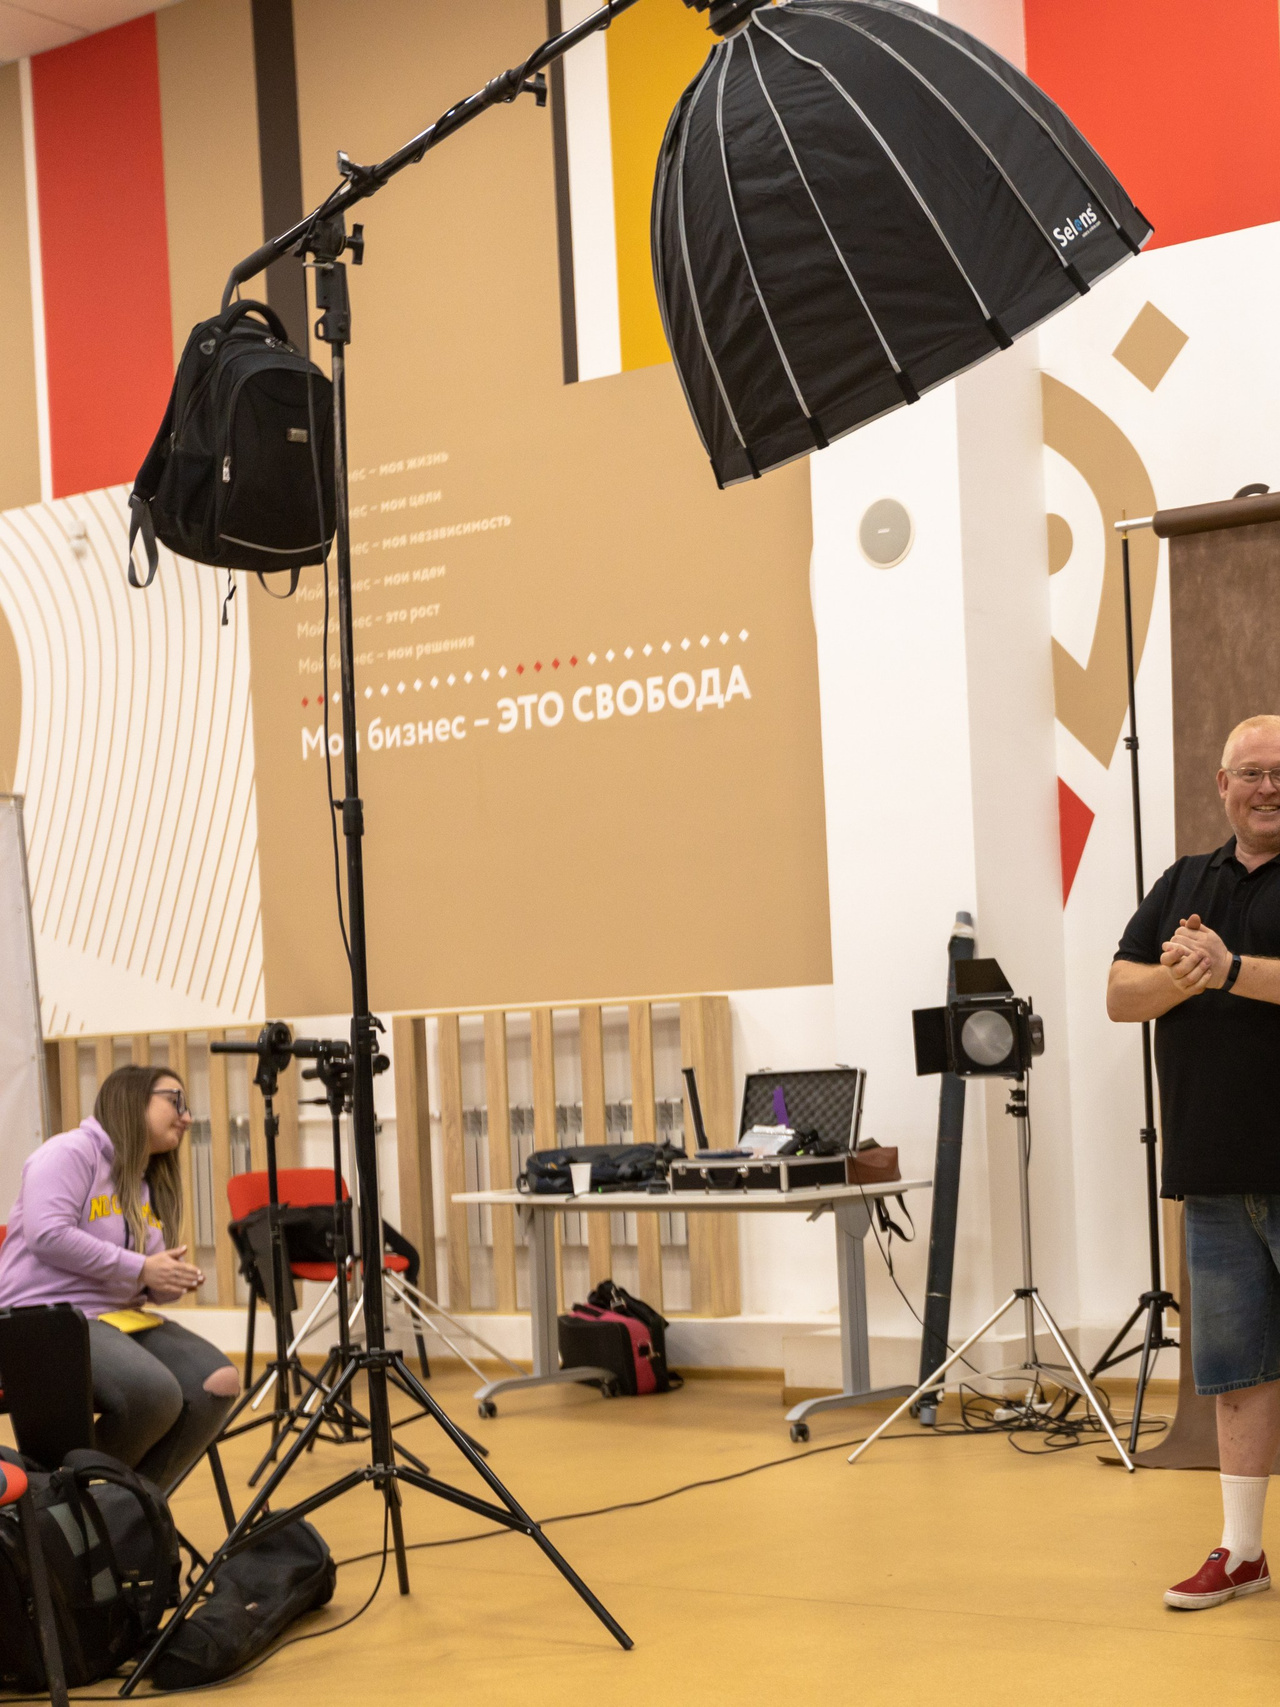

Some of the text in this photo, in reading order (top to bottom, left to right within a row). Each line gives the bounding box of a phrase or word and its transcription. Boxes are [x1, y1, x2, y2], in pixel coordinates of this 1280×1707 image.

[1052, 206, 1098, 248] Selens
[406, 450, 449, 471] жизнь
[409, 489, 442, 509] цели
[409, 514, 512, 545] независимость
[413, 564, 446, 583] идеи
[385, 608, 408, 625] это
[410, 602, 441, 624] рост
[415, 634, 476, 660] решения
[367, 713, 466, 752] бизнес
[496, 690, 565, 734] ЭТО
[571, 664, 752, 723] СВОБОДА
